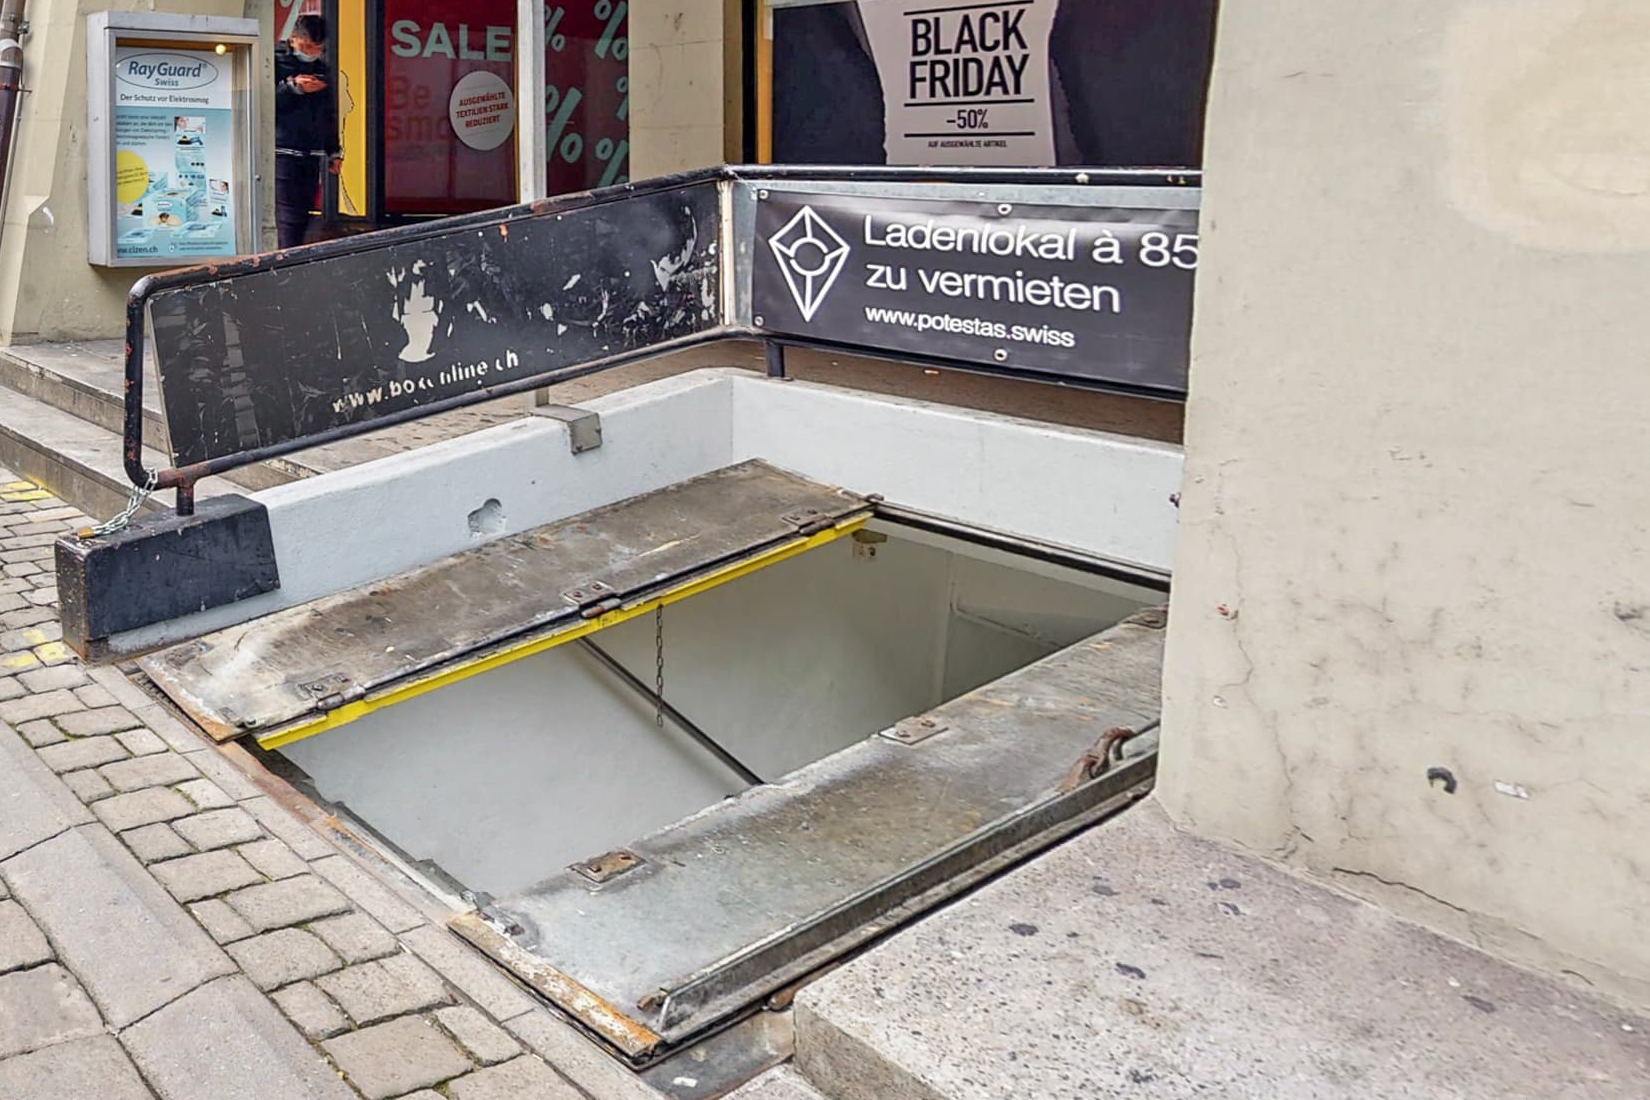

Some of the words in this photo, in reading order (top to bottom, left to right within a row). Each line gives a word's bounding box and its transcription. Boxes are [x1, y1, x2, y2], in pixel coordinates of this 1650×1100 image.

[391, 19, 512, 62] SALE
[911, 8, 1028, 57] BLACK
[120, 93, 132, 101] Der
[154, 78, 179, 86] Swiss
[909, 54, 1030, 99] FRIDAY
[465, 115, 500, 128] REDUZIERT
[863, 214, 1077, 261] Ladenlokal
[1091, 229, 1124, 265] à
[1139, 232, 1199, 269] 85
[865, 263, 907, 291] zu
[918, 269, 1121, 313] vermieten
[865, 306, 1076, 348] www.potestas.swiss
